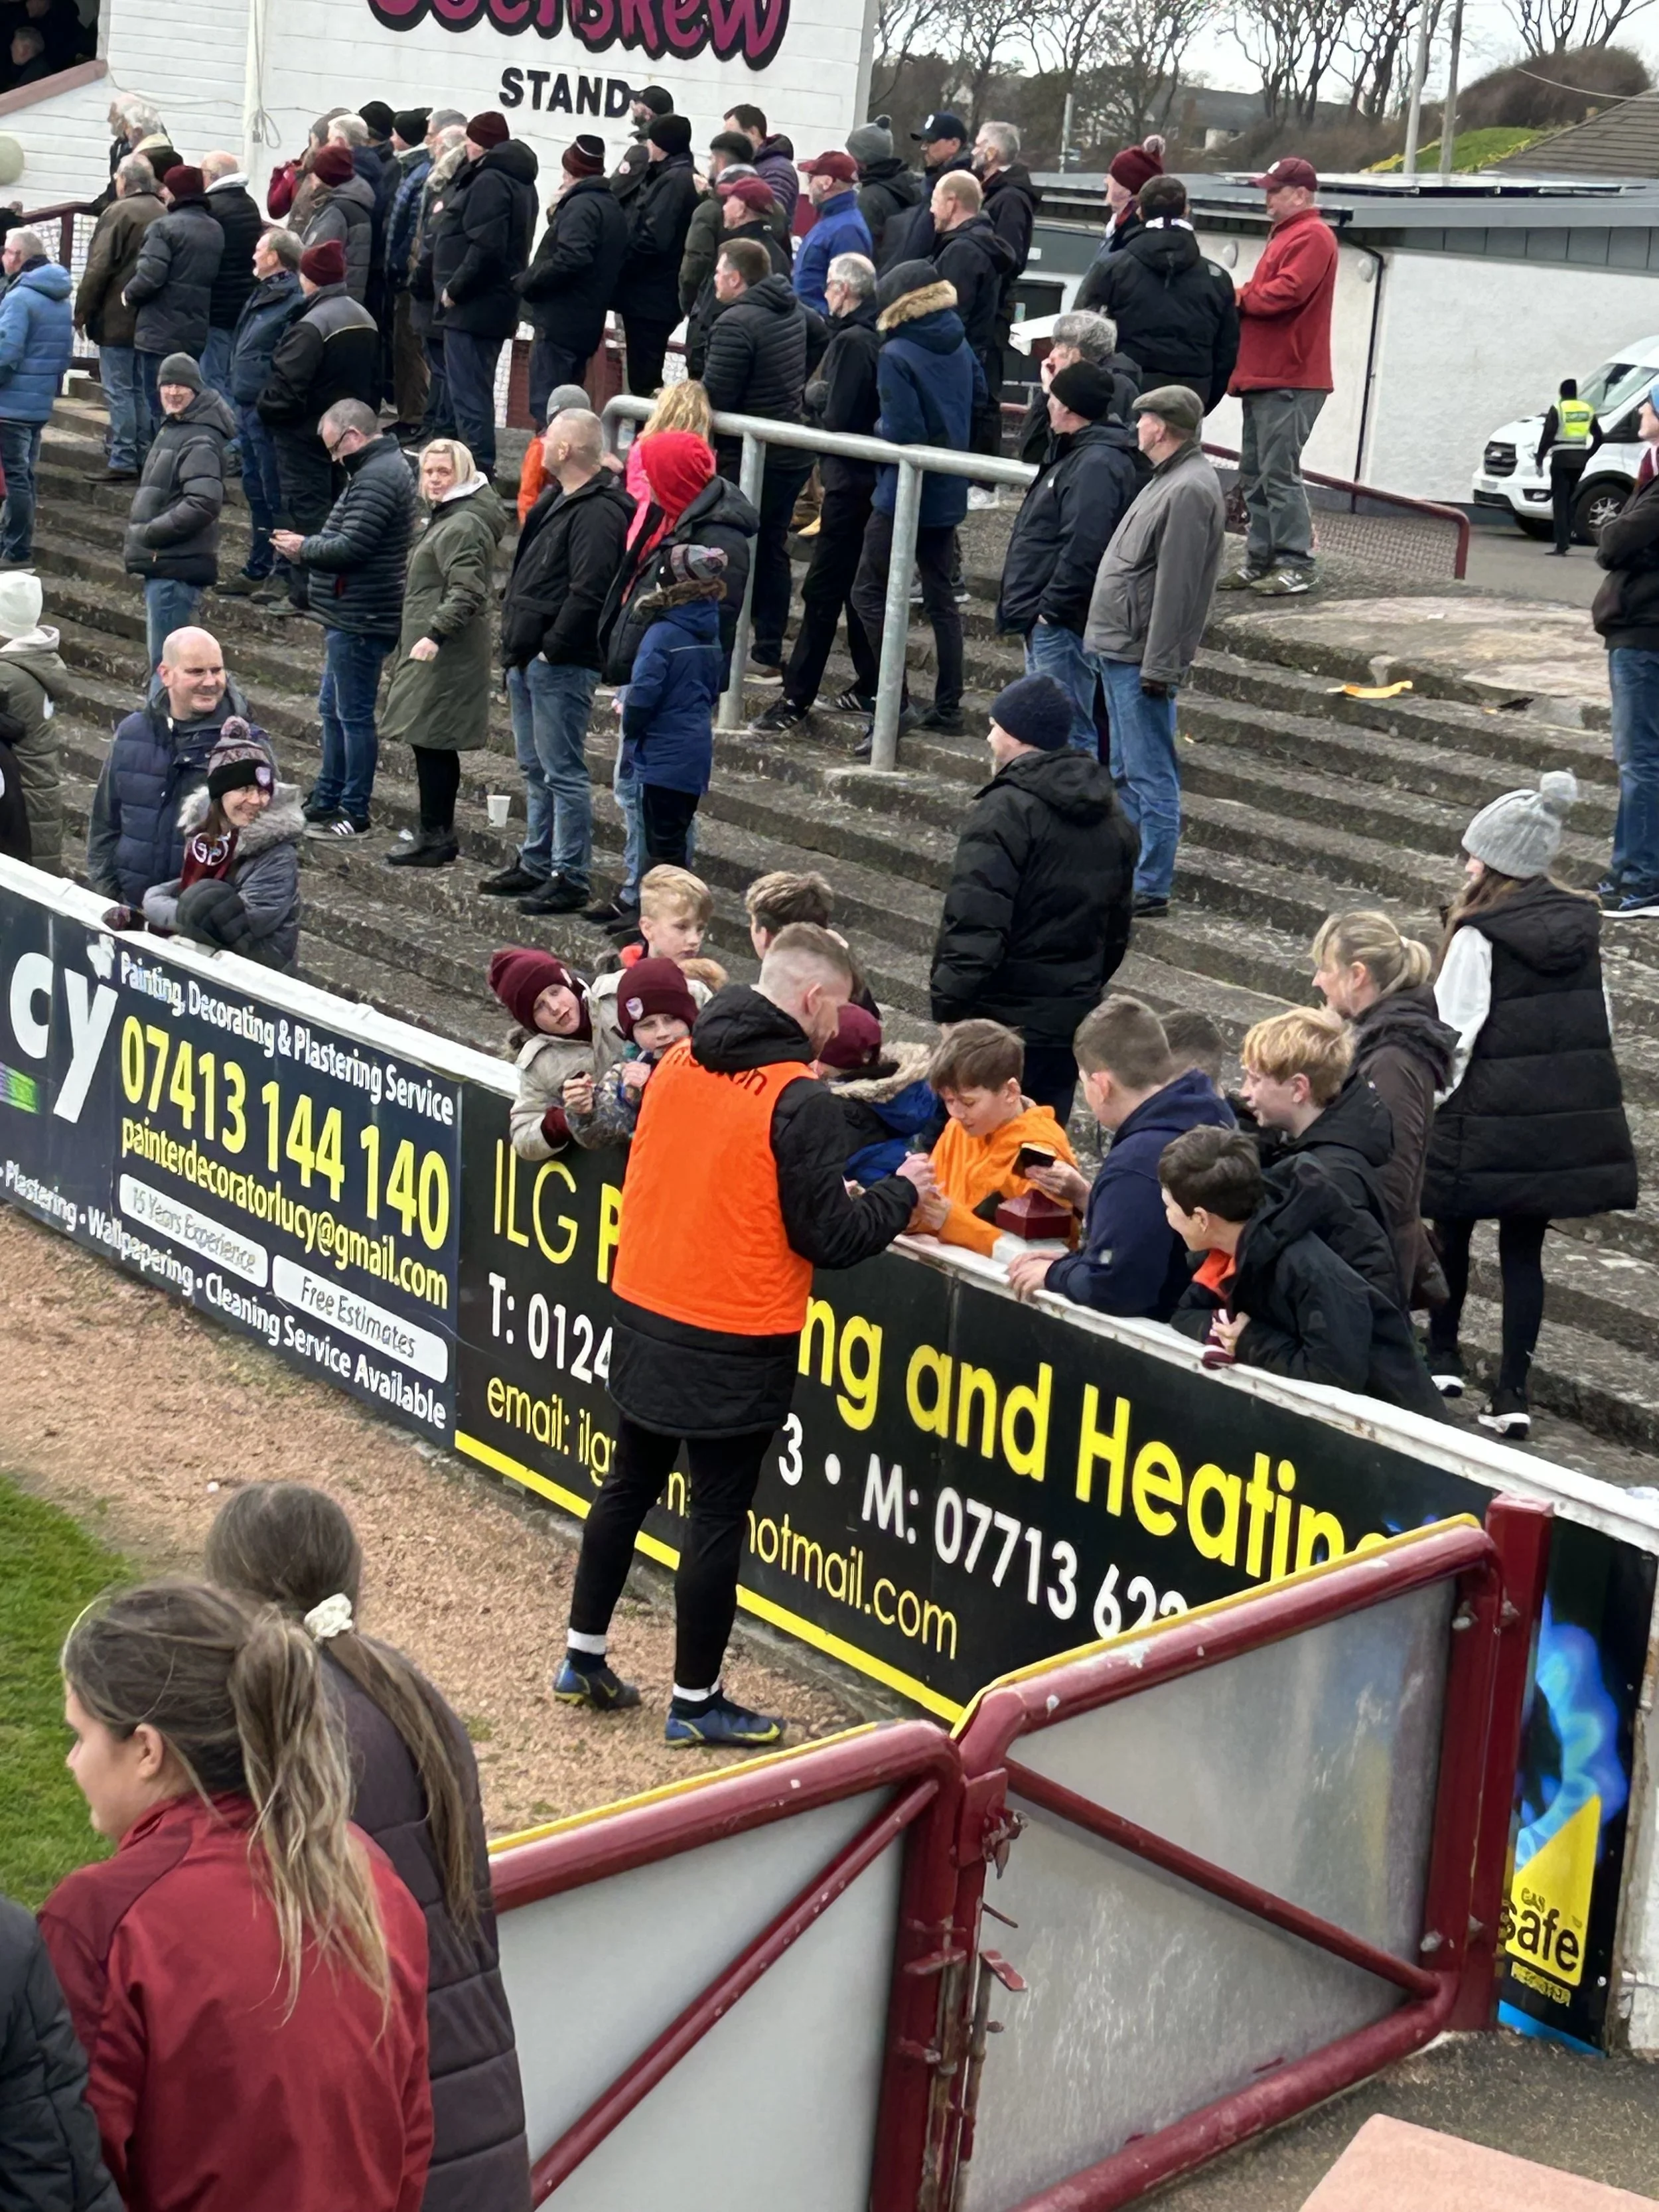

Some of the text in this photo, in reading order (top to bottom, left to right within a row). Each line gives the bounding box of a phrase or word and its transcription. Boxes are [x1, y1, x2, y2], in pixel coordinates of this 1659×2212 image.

[498, 67, 632, 117] STAND
[121, 1015, 450, 1250] 07413 144 140
[188, 980, 275, 1058] Decorating
[278, 1019, 292, 1057] &
[294, 1025, 382, 1104] Plastering
[386, 1064, 454, 1125] Service
[122, 1116, 448, 1309] painterdecoratorlucy@gmail.com
[206, 1272, 281, 1347] Cleaning
[283, 1315, 351, 1378] Service
[354, 1354, 447, 1430] Available
[301, 1276, 417, 1358] Free Estimates
[494, 1139, 1388, 1582] ILG P ng and Heatin
[487, 1376, 569, 1455] email:
[747, 1509, 957, 1660] otmail.com
[488, 1272, 514, 1345] T:
[528, 1293, 613, 1384] 0124
[778, 1412, 803, 1486] 3
[862, 1453, 919, 1544] M:
[935, 1487, 1078, 1620] 07713
